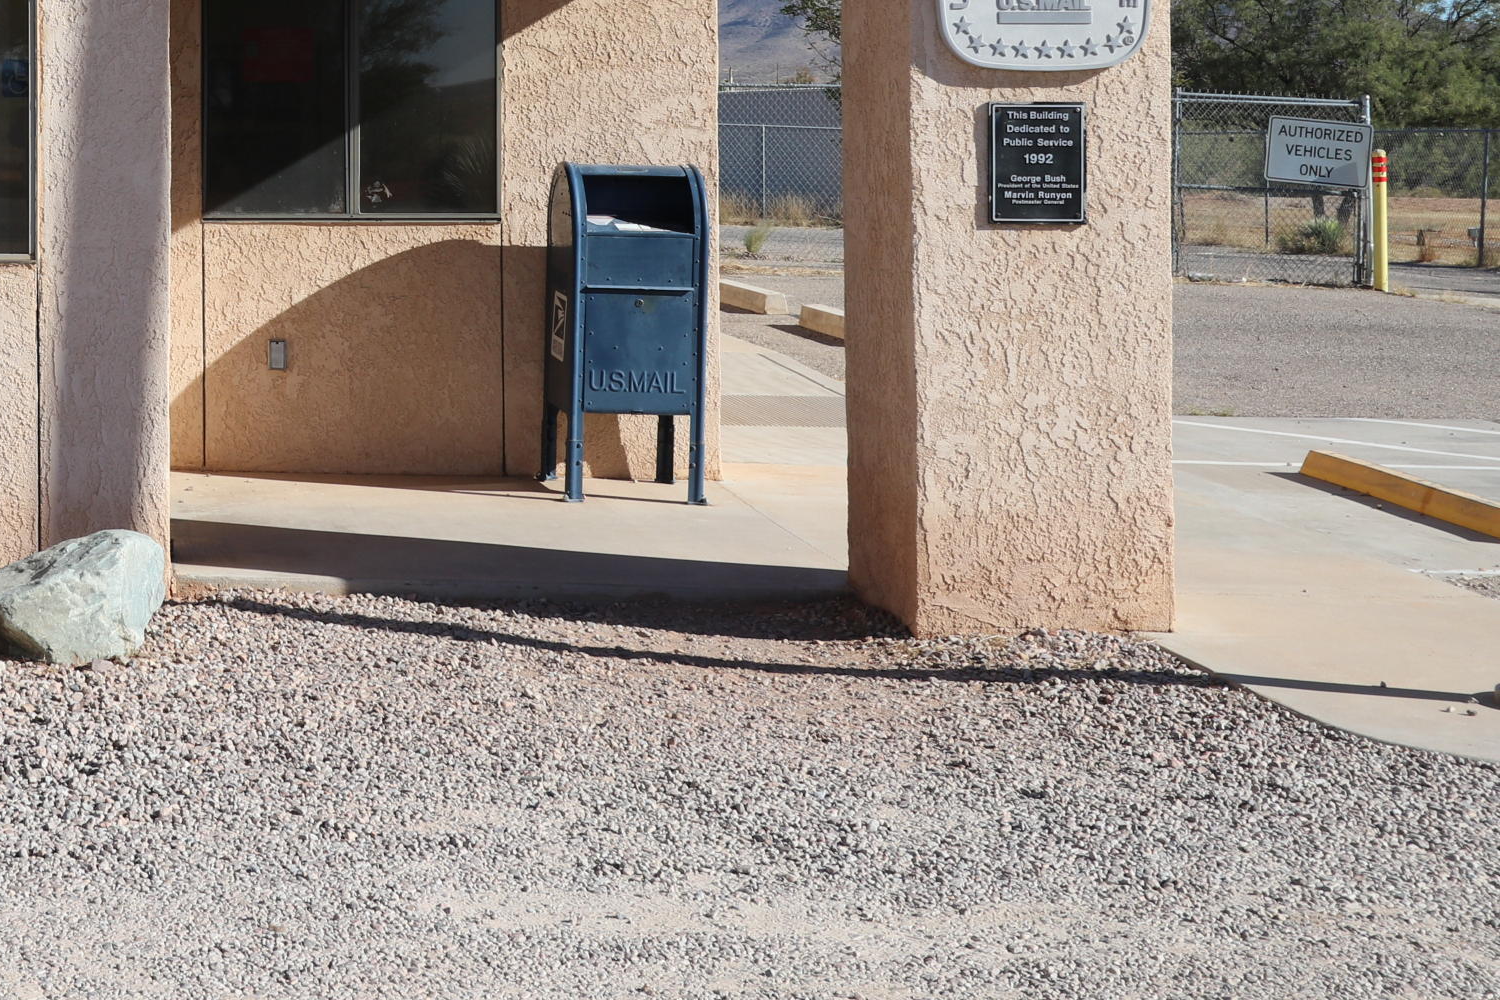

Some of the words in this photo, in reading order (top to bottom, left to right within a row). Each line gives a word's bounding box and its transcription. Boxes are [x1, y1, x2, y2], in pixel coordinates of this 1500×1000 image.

[1007, 111, 1028, 119] This
[1030, 111, 1069, 121] Building
[1006, 124, 1056, 133] Dedicated
[1060, 125, 1070, 133] to
[1278, 124, 1364, 143] AUTHORIZED
[1003, 137, 1034, 147] Public
[1037, 137, 1074, 147] Service
[1285, 143, 1353, 161] VEHICLES
[1023, 153, 1054, 164] 1992
[1299, 163, 1334, 178] ONLY
[1010, 174, 1042, 183] George
[1044, 174, 1066, 182] Bush
[1004, 191, 1035, 199] Marvin
[1038, 190, 1073, 200] Runyon
[589, 369, 686, 394] U.S.MAIL
